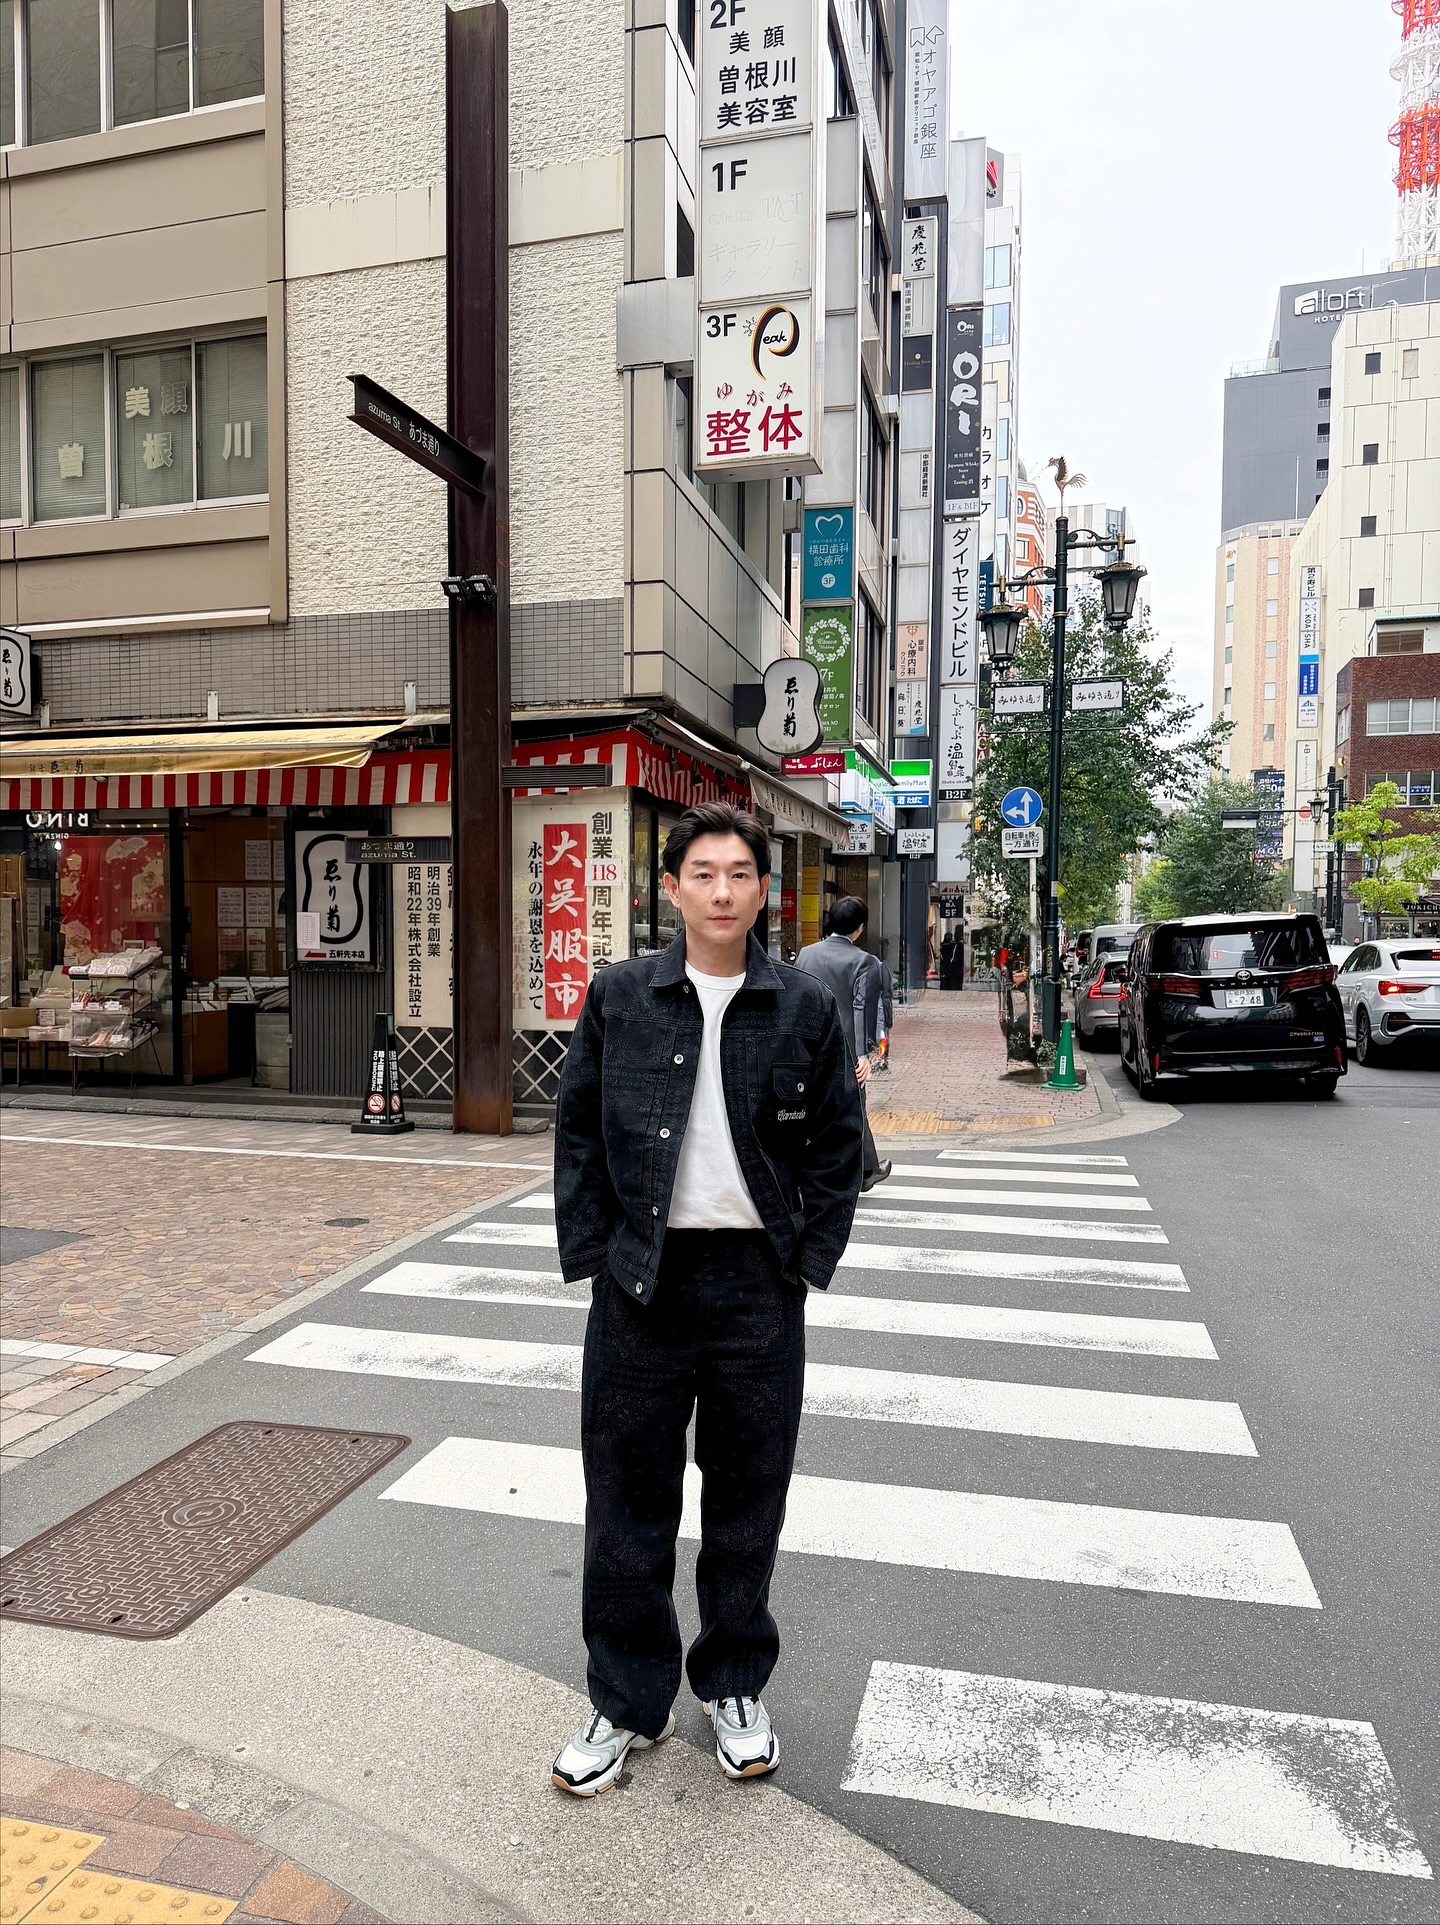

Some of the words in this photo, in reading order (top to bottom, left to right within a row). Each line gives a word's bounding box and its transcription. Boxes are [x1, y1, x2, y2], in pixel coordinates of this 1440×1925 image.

[710, 0, 746, 29] 2F
[729, 25, 785, 54] 美顔
[719, 56, 796, 95] 曽根川
[717, 94, 797, 130] 美容室
[920, 49, 938, 160] オヤアゴ銀座
[711, 158, 748, 193] 1F
[762, 191, 804, 224] TACT
[708, 237, 796, 263] ギャラリー
[722, 260, 803, 287] タクト
[1294, 286, 1365, 316] aloft
[706, 313, 738, 338] 3F
[716, 382, 794, 407] ゆがみ
[368, 402, 392, 424] azuma
[392, 416, 402, 432] St.
[706, 403, 803, 457] 整体
[408, 421, 440, 457] あづま通り
[980, 426, 992, 515] カラオケ
[808, 542, 850, 556] 横田歯科
[813, 554, 845, 567] 診療所
[823, 576, 835, 586] 3F
[949, 526, 972, 678] ダイヤモンドビル
[907, 640, 917, 677] 心療内科
[784, 676, 799, 738] ゑり菊
[998, 694, 1041, 705] みゆき通り
[1075, 690, 1120, 702] みゆき通り
[897, 779, 928, 788] amilyMart
[945, 790, 967, 800] B2F
[1005, 831, 1039, 841] 自転車を除く
[1005, 840, 1039, 849] 一方通行
[361, 851, 398, 859] azuma
[401, 850, 417, 859] St.
[323, 858, 342, 933] ゑり菊
[1405, 903, 1440, 911] JOKICH
[426, 866, 442, 956] 明治39年創業
[945, 909, 957, 917] 5F
[527, 840, 545, 1012] 永年の謝恩を込めて
[329, 950, 365, 959] 五軒先本店
[406, 866, 424, 1018] 昭和22年株式会社設立
[372, 1050, 379, 1061] NO
[370, 1061, 378, 1092] SMOKING
